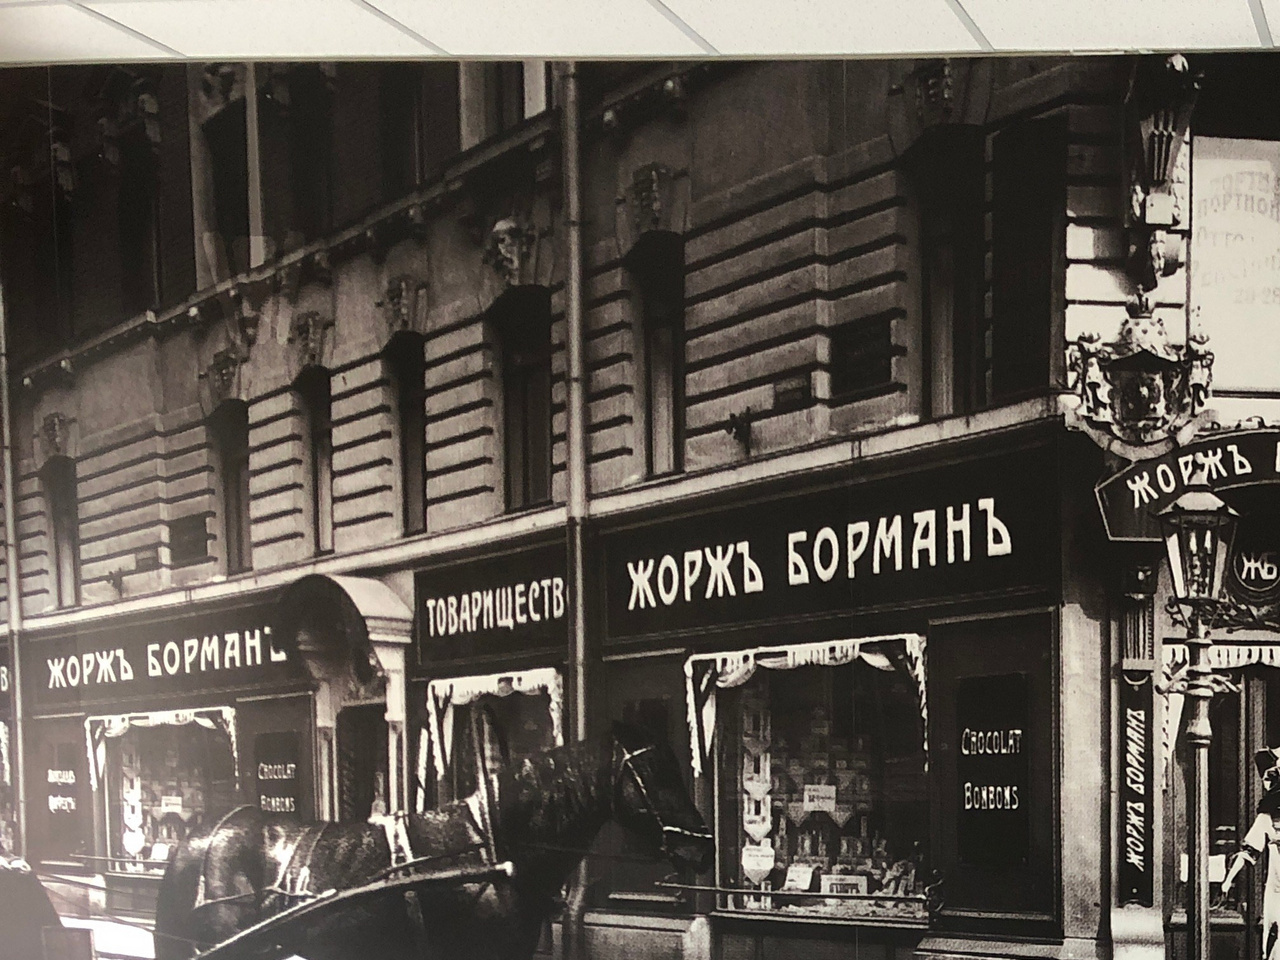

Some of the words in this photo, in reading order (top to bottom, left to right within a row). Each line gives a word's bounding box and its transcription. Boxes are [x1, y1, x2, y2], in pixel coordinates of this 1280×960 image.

[1126, 444, 1252, 509] ЖОРЖЪ
[627, 540, 764, 611] ЖОРЖЪ
[788, 498, 1012, 586] БОРМАНЪ
[426, 577, 569, 637] ТОВАРИЩЕСТВ
[47, 649, 134, 689] ЖОРЖЪ
[1126, 707, 1146, 795] БОРМАНЪ
[1126, 801, 1145, 872] ЖОРЖЪ
